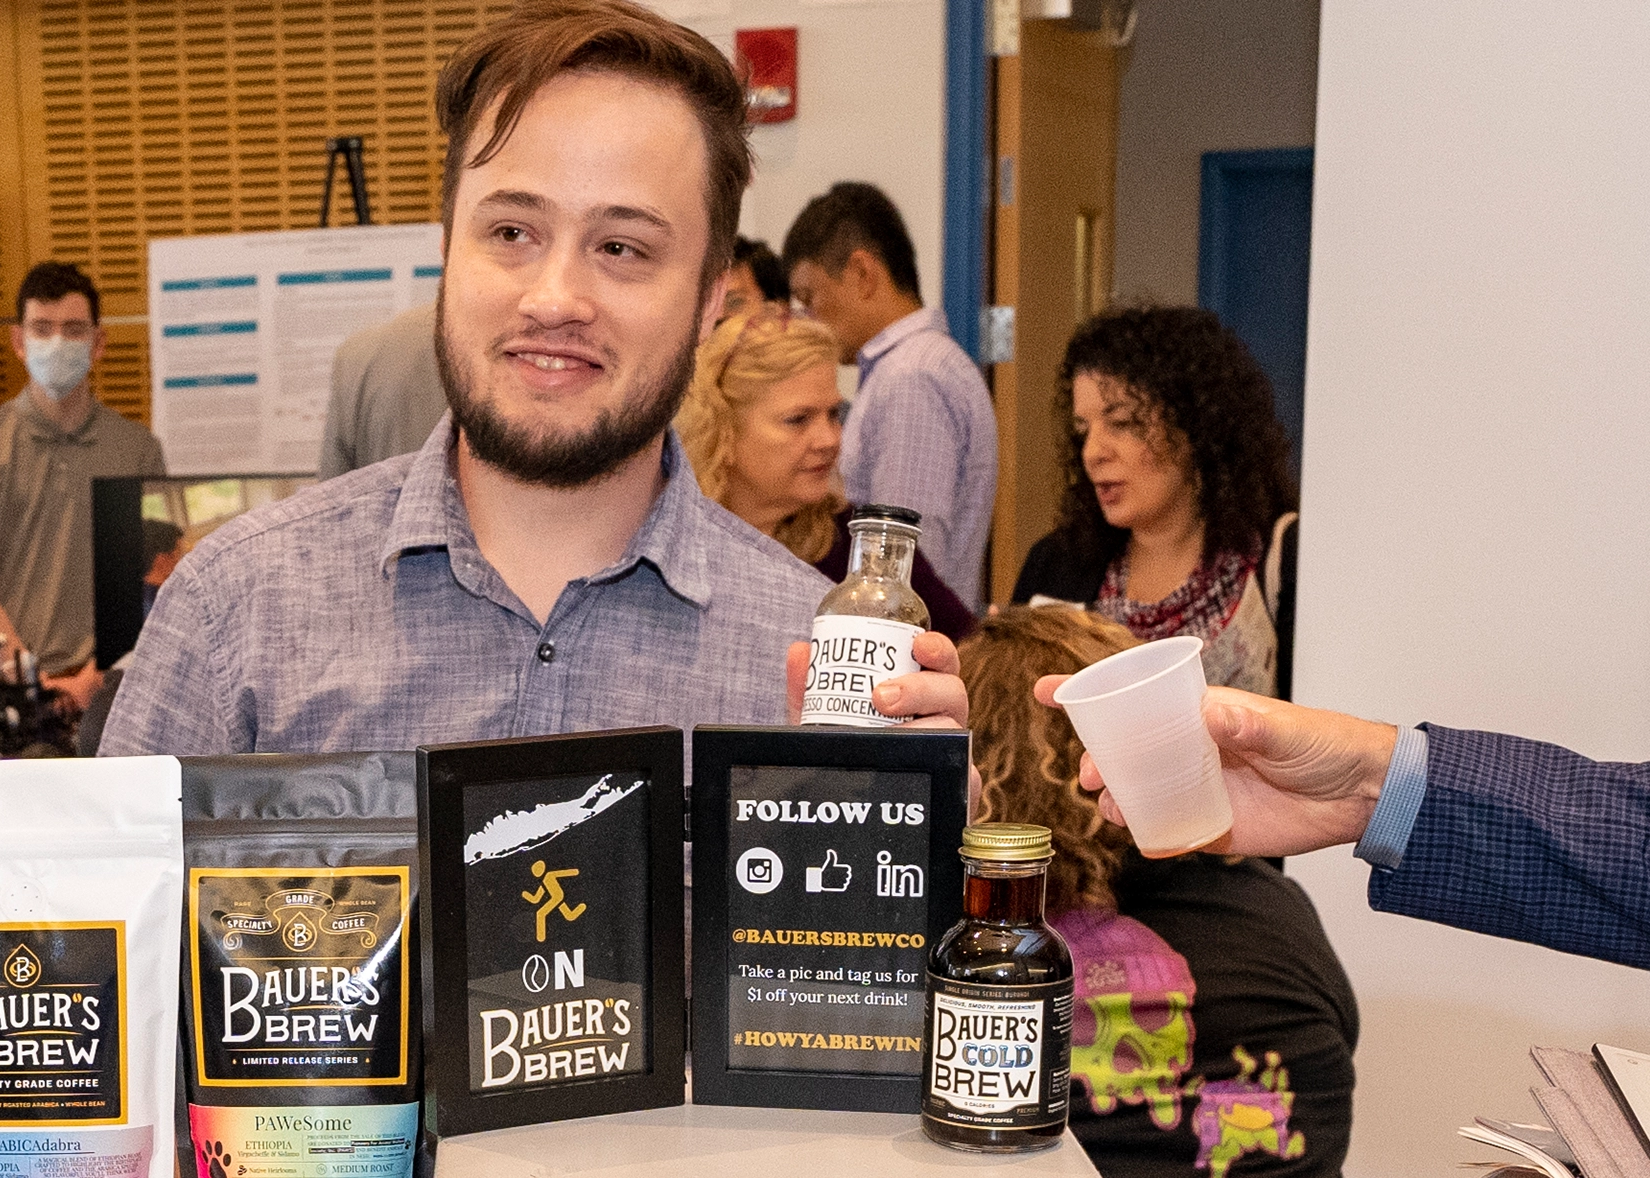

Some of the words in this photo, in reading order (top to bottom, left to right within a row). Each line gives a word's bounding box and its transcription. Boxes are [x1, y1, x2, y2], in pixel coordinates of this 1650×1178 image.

[817, 671, 874, 692] BRE
[736, 800, 872, 823] FOLLOW
[880, 802, 925, 825] US
[286, 895, 315, 904] GRADE
[227, 920, 273, 929] SPECIALTY
[331, 918, 365, 930] COFFEE
[732, 929, 925, 948] @BAUERSBREWCO
[738, 964, 774, 979] Take
[777, 968, 786, 979] a
[789, 966, 813, 983] pic
[816, 967, 844, 981] and
[847, 969, 872, 984] tag
[875, 972, 893, 983] us
[896, 969, 919, 983] for
[747, 986, 763, 1002] $1
[766, 988, 788, 1002] off
[789, 991, 824, 1006] your
[827, 991, 861, 1005] next
[864, 991, 908, 1006] drink!
[265, 1015, 378, 1042] BREW
[936, 1007, 1038, 1061] BAUER'S
[480, 998, 631, 1088] BAUER'S
[733, 1031, 922, 1052] #HOWYABREWIN
[242, 1057, 279, 1065] LIMITED
[282, 1057, 322, 1065] RELEASE
[325, 1056, 358, 1064] SERIES
[523, 1042, 630, 1083] BREW
[961, 1042, 1034, 1068] COLD
[14, 1079, 53, 1088] GRADE
[56, 1079, 99, 1088] COFFEE
[934, 1062, 1036, 1098] BREW
[255, 1115, 352, 1132] PAWeSome
[245, 1141, 292, 1150] ETHIOPIA
[332, 1165, 368, 1173] MEDIUM
[370, 1164, 394, 1173] ROAST
